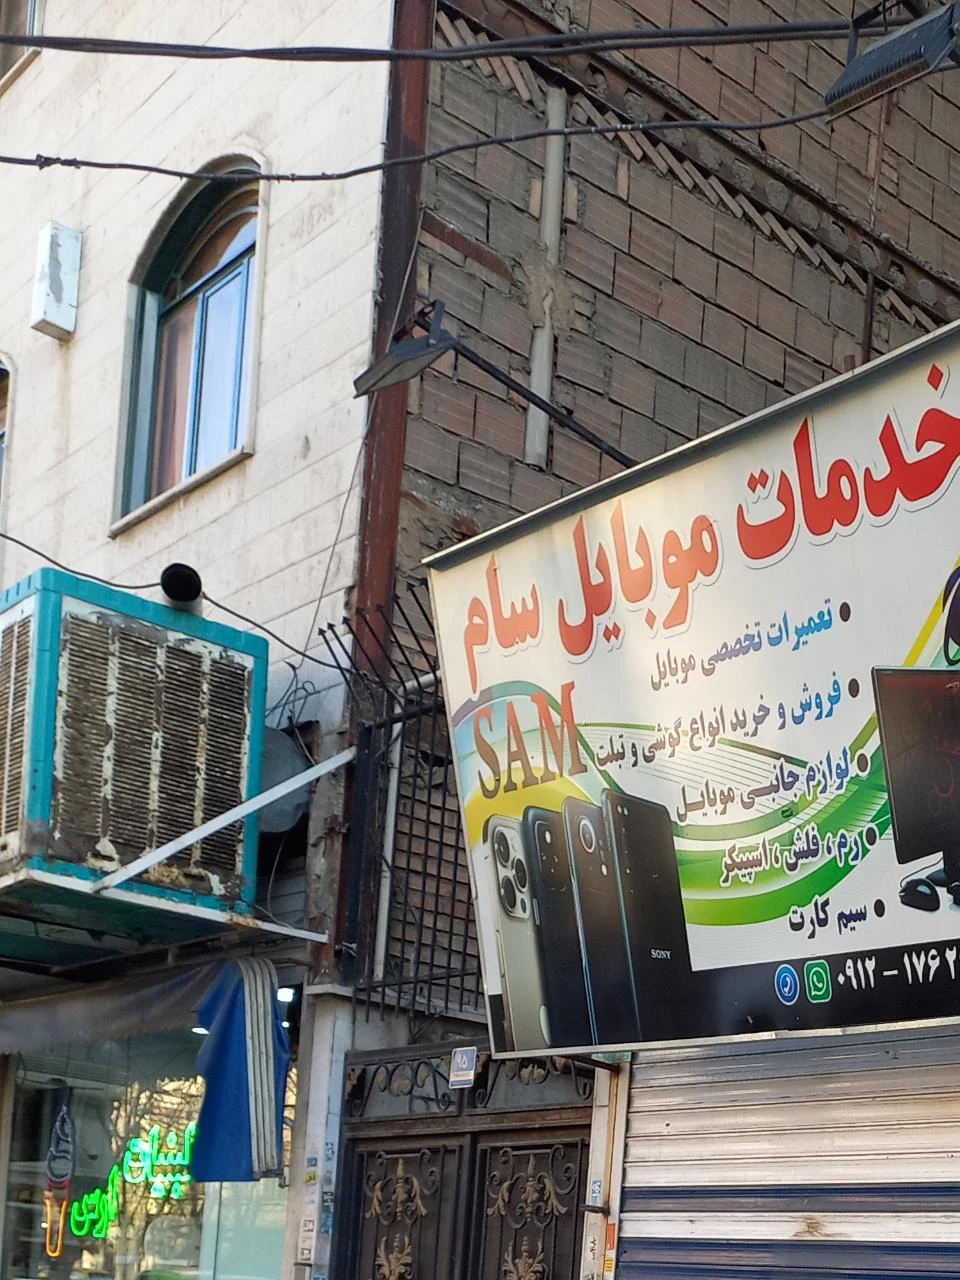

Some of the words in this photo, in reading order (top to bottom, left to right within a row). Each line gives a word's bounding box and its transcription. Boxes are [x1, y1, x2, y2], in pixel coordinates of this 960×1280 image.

[558, 499, 720, 656] موبایل
[463, 554, 540, 692] سام
[767, 598, 833, 651] تعمیرات
[650, 650, 696, 691] موبایل
[701, 622, 761, 677] تخصصی
[730, 694, 770, 738] خرید
[777, 702, 786, 730] و
[791, 672, 841, 725] فروش
[473, 681, 588, 799] SAM
[642, 718, 682, 763] گوشی
[689, 705, 725, 751] انواع
[596, 734, 625, 769] تبلت
[631, 742, 638, 767] و
[805, 746, 851, 796] لوازم
[677, 780, 735, 822] موبایل
[740, 758, 800, 809] جانبی
[722, 838, 767, 884] اسپیکر
[789, 898, 829, 939] کارت
[837, 904, 867, 934] سیم
[650, 948, 671, 960] SONY
